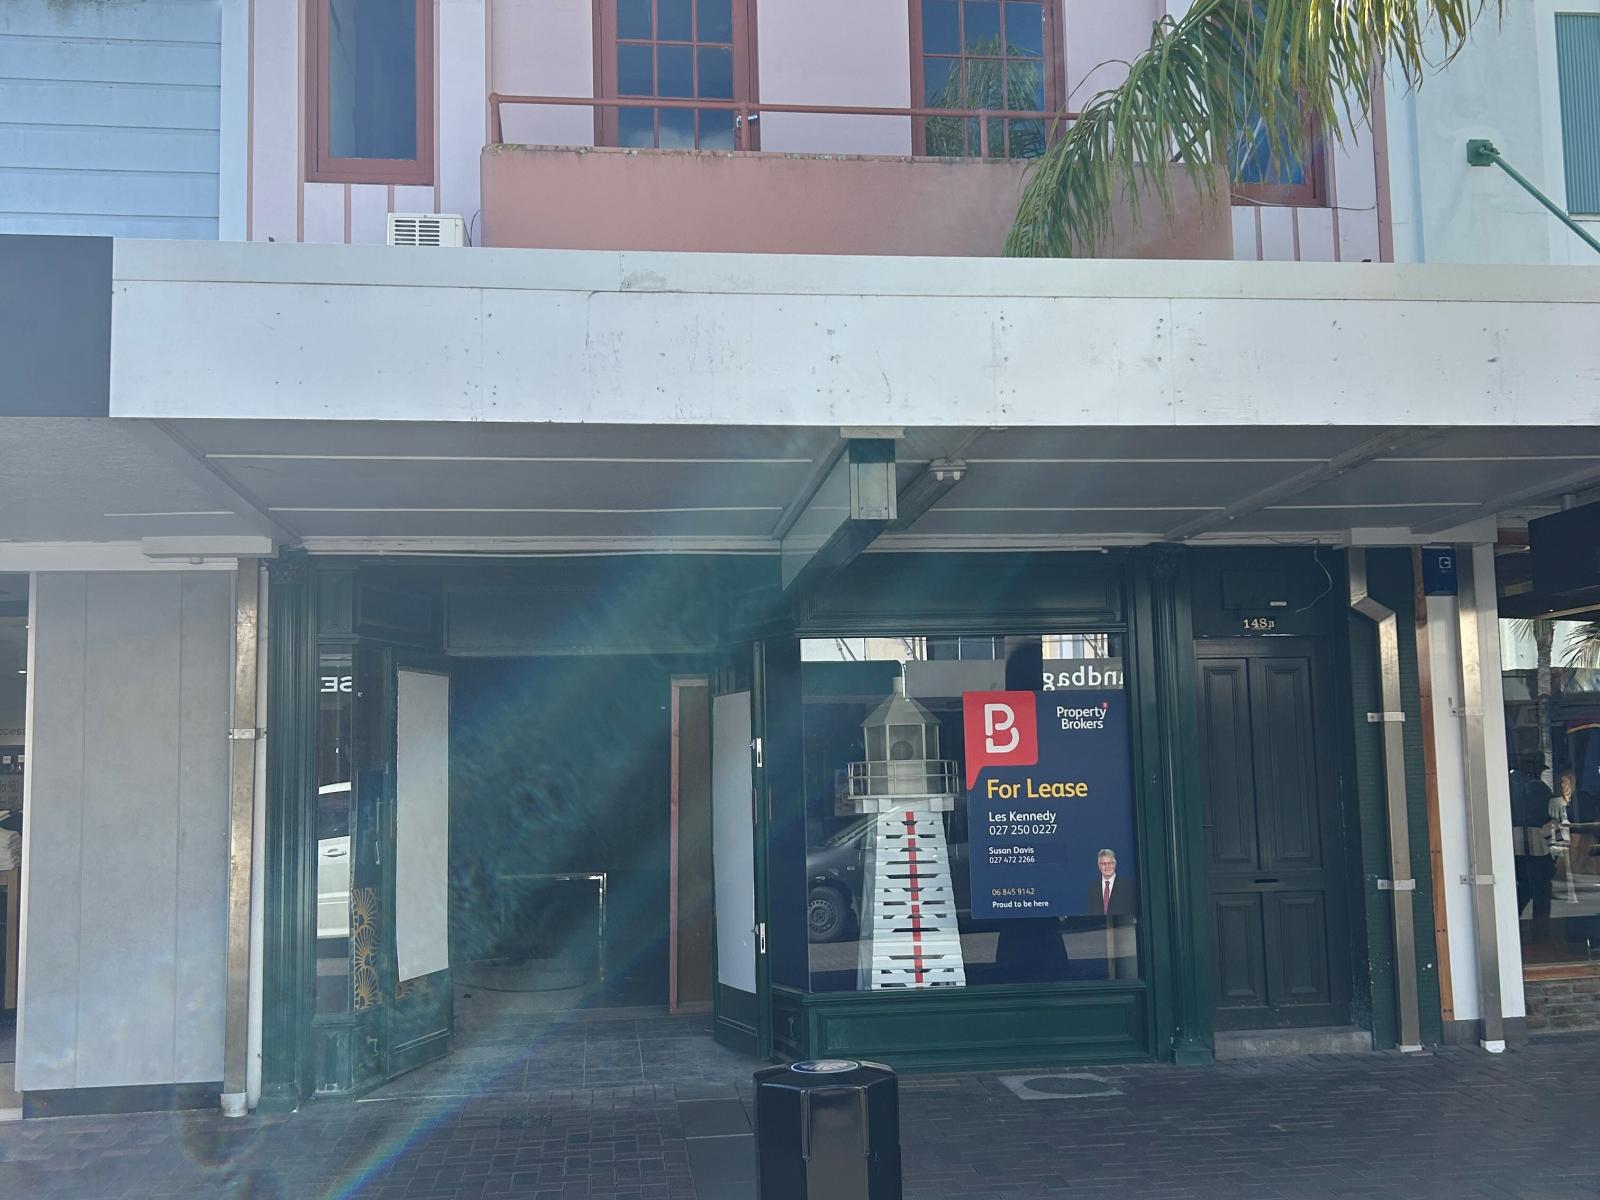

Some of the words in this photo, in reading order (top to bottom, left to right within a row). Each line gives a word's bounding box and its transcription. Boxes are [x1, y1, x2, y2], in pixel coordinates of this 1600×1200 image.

[1056, 706, 1107, 720] Property
[1061, 718, 1104, 730] Brokers
[987, 779, 1020, 799] For
[1026, 778, 1089, 798] Lease
[988, 811, 1007, 822] Les
[1009, 810, 1057, 824] Kennedy
[989, 825, 1008, 835] 027
[1011, 825, 1030, 835] 250
[1032, 824, 1058, 834] 0227
[988, 846, 1012, 855] Susan
[1013, 846, 1035, 854] Davis
[1018, 855, 1035, 863] 2266
[991, 888, 1001, 896] 06
[992, 901, 1013, 909] Proud
[1014, 900, 1022, 908] to
[1023, 900, 1032, 908] be
[1033, 899, 1049, 907] here
